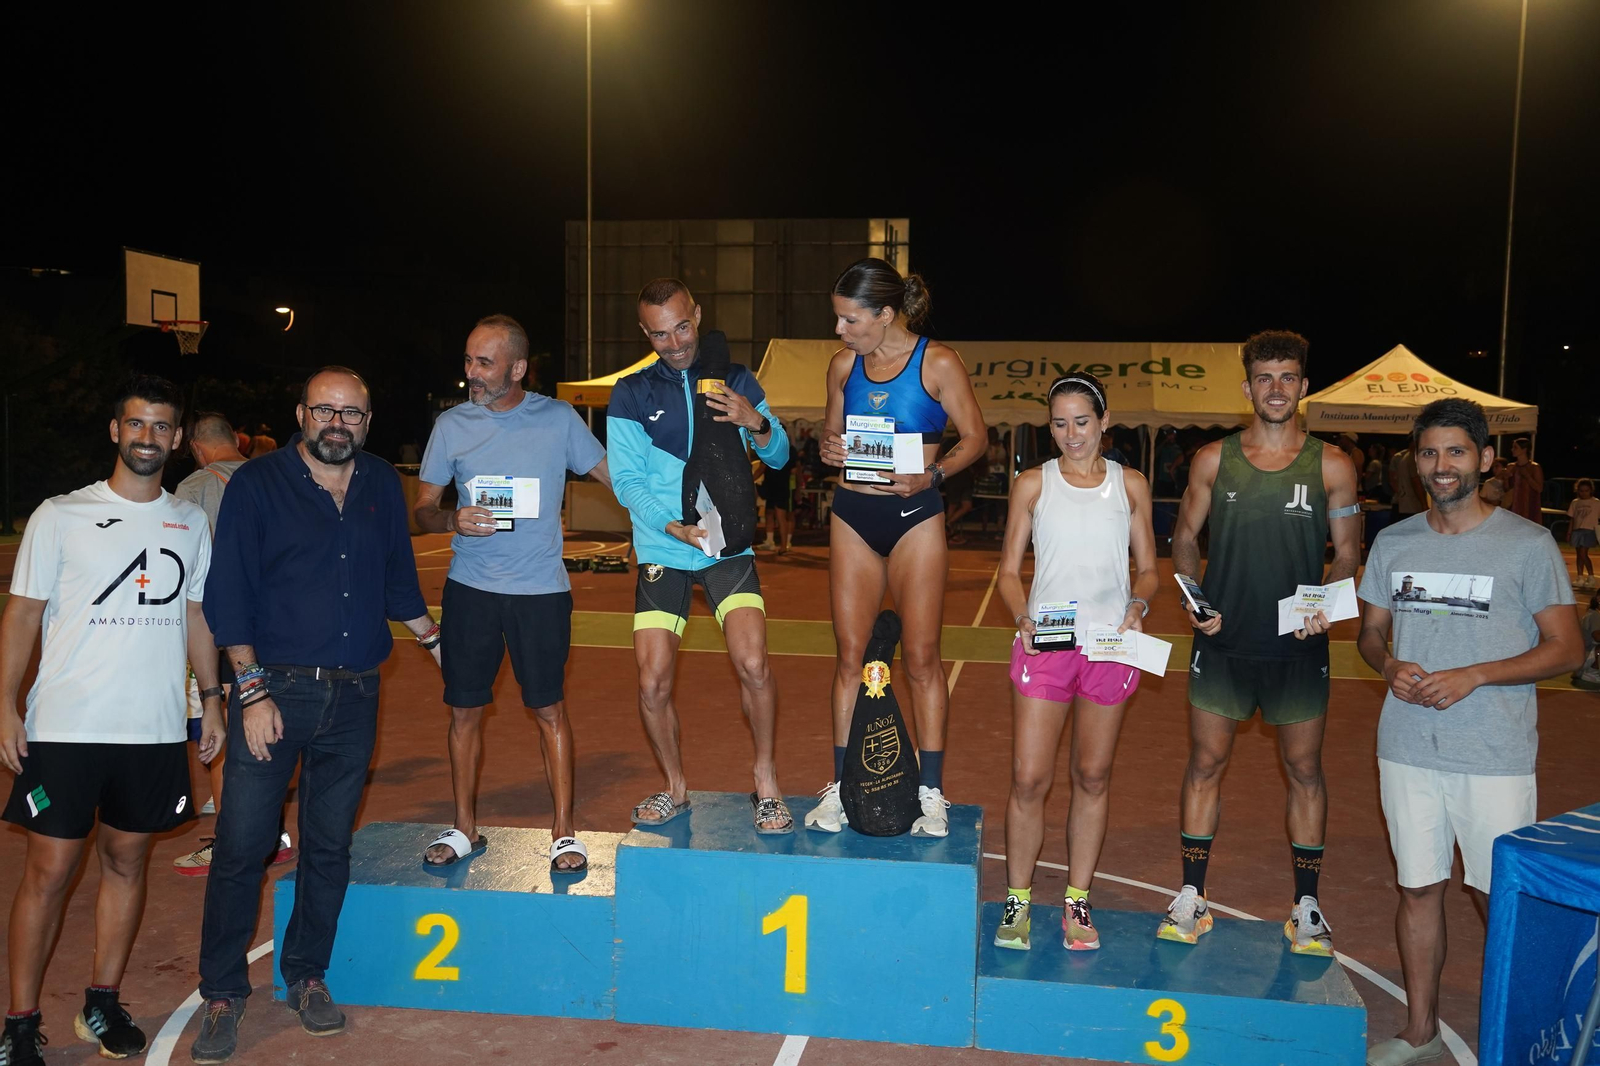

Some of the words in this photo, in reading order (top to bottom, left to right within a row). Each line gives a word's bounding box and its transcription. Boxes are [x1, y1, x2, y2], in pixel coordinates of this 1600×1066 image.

[969, 357, 1206, 379] urgiverde
[1367, 383, 1391, 394] EL
[1398, 383, 1458, 396] EJIDO
[850, 420, 891, 430] Murgiverde
[1320, 410, 1359, 421] Instituto
[1361, 412, 1410, 423] Municipal
[1495, 412, 1521, 424] Ejido
[88, 617, 182, 626] AMASDESTUDIO
[414, 913, 460, 981] 2
[762, 894, 808, 994] 1
[1145, 998, 1190, 1062] 3
